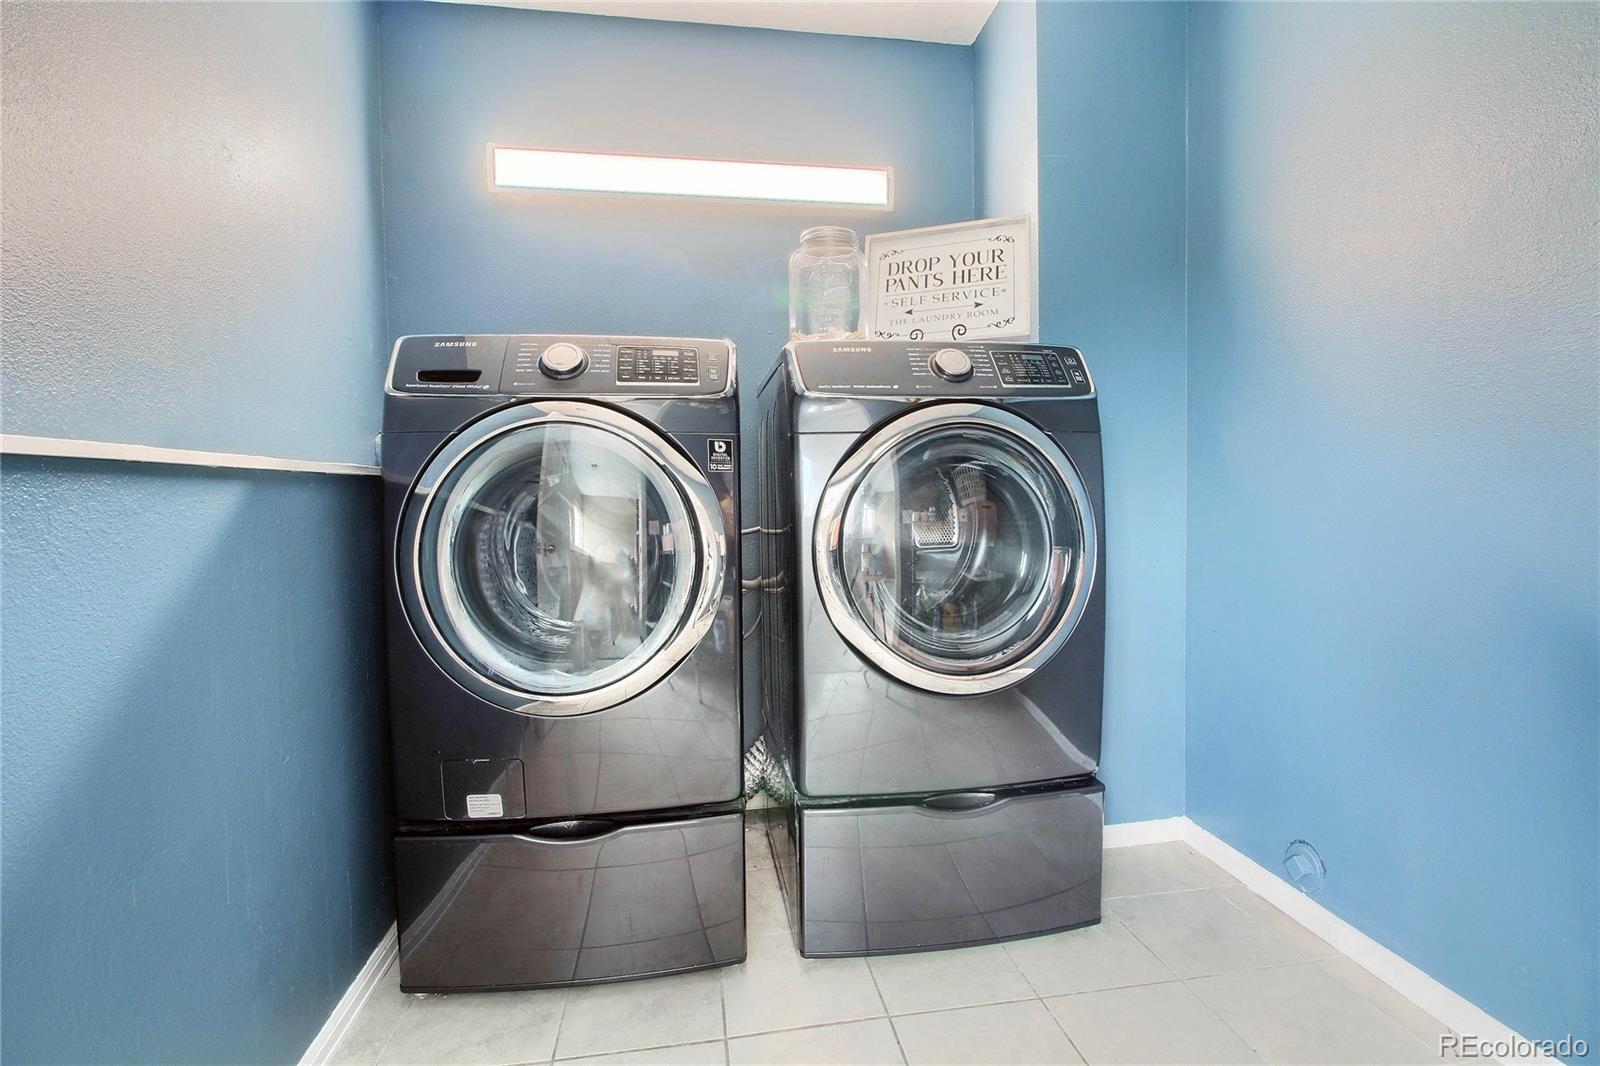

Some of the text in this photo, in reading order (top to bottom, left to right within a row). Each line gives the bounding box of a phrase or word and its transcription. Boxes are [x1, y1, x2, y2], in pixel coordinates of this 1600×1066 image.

[888, 248, 1005, 276] DROP YOUR
[885, 264, 1008, 293] PANTS HERE
[890, 287, 1001, 308] SELF SERVICE
[890, 308, 1000, 327] THE LAUNDRY ROOM
